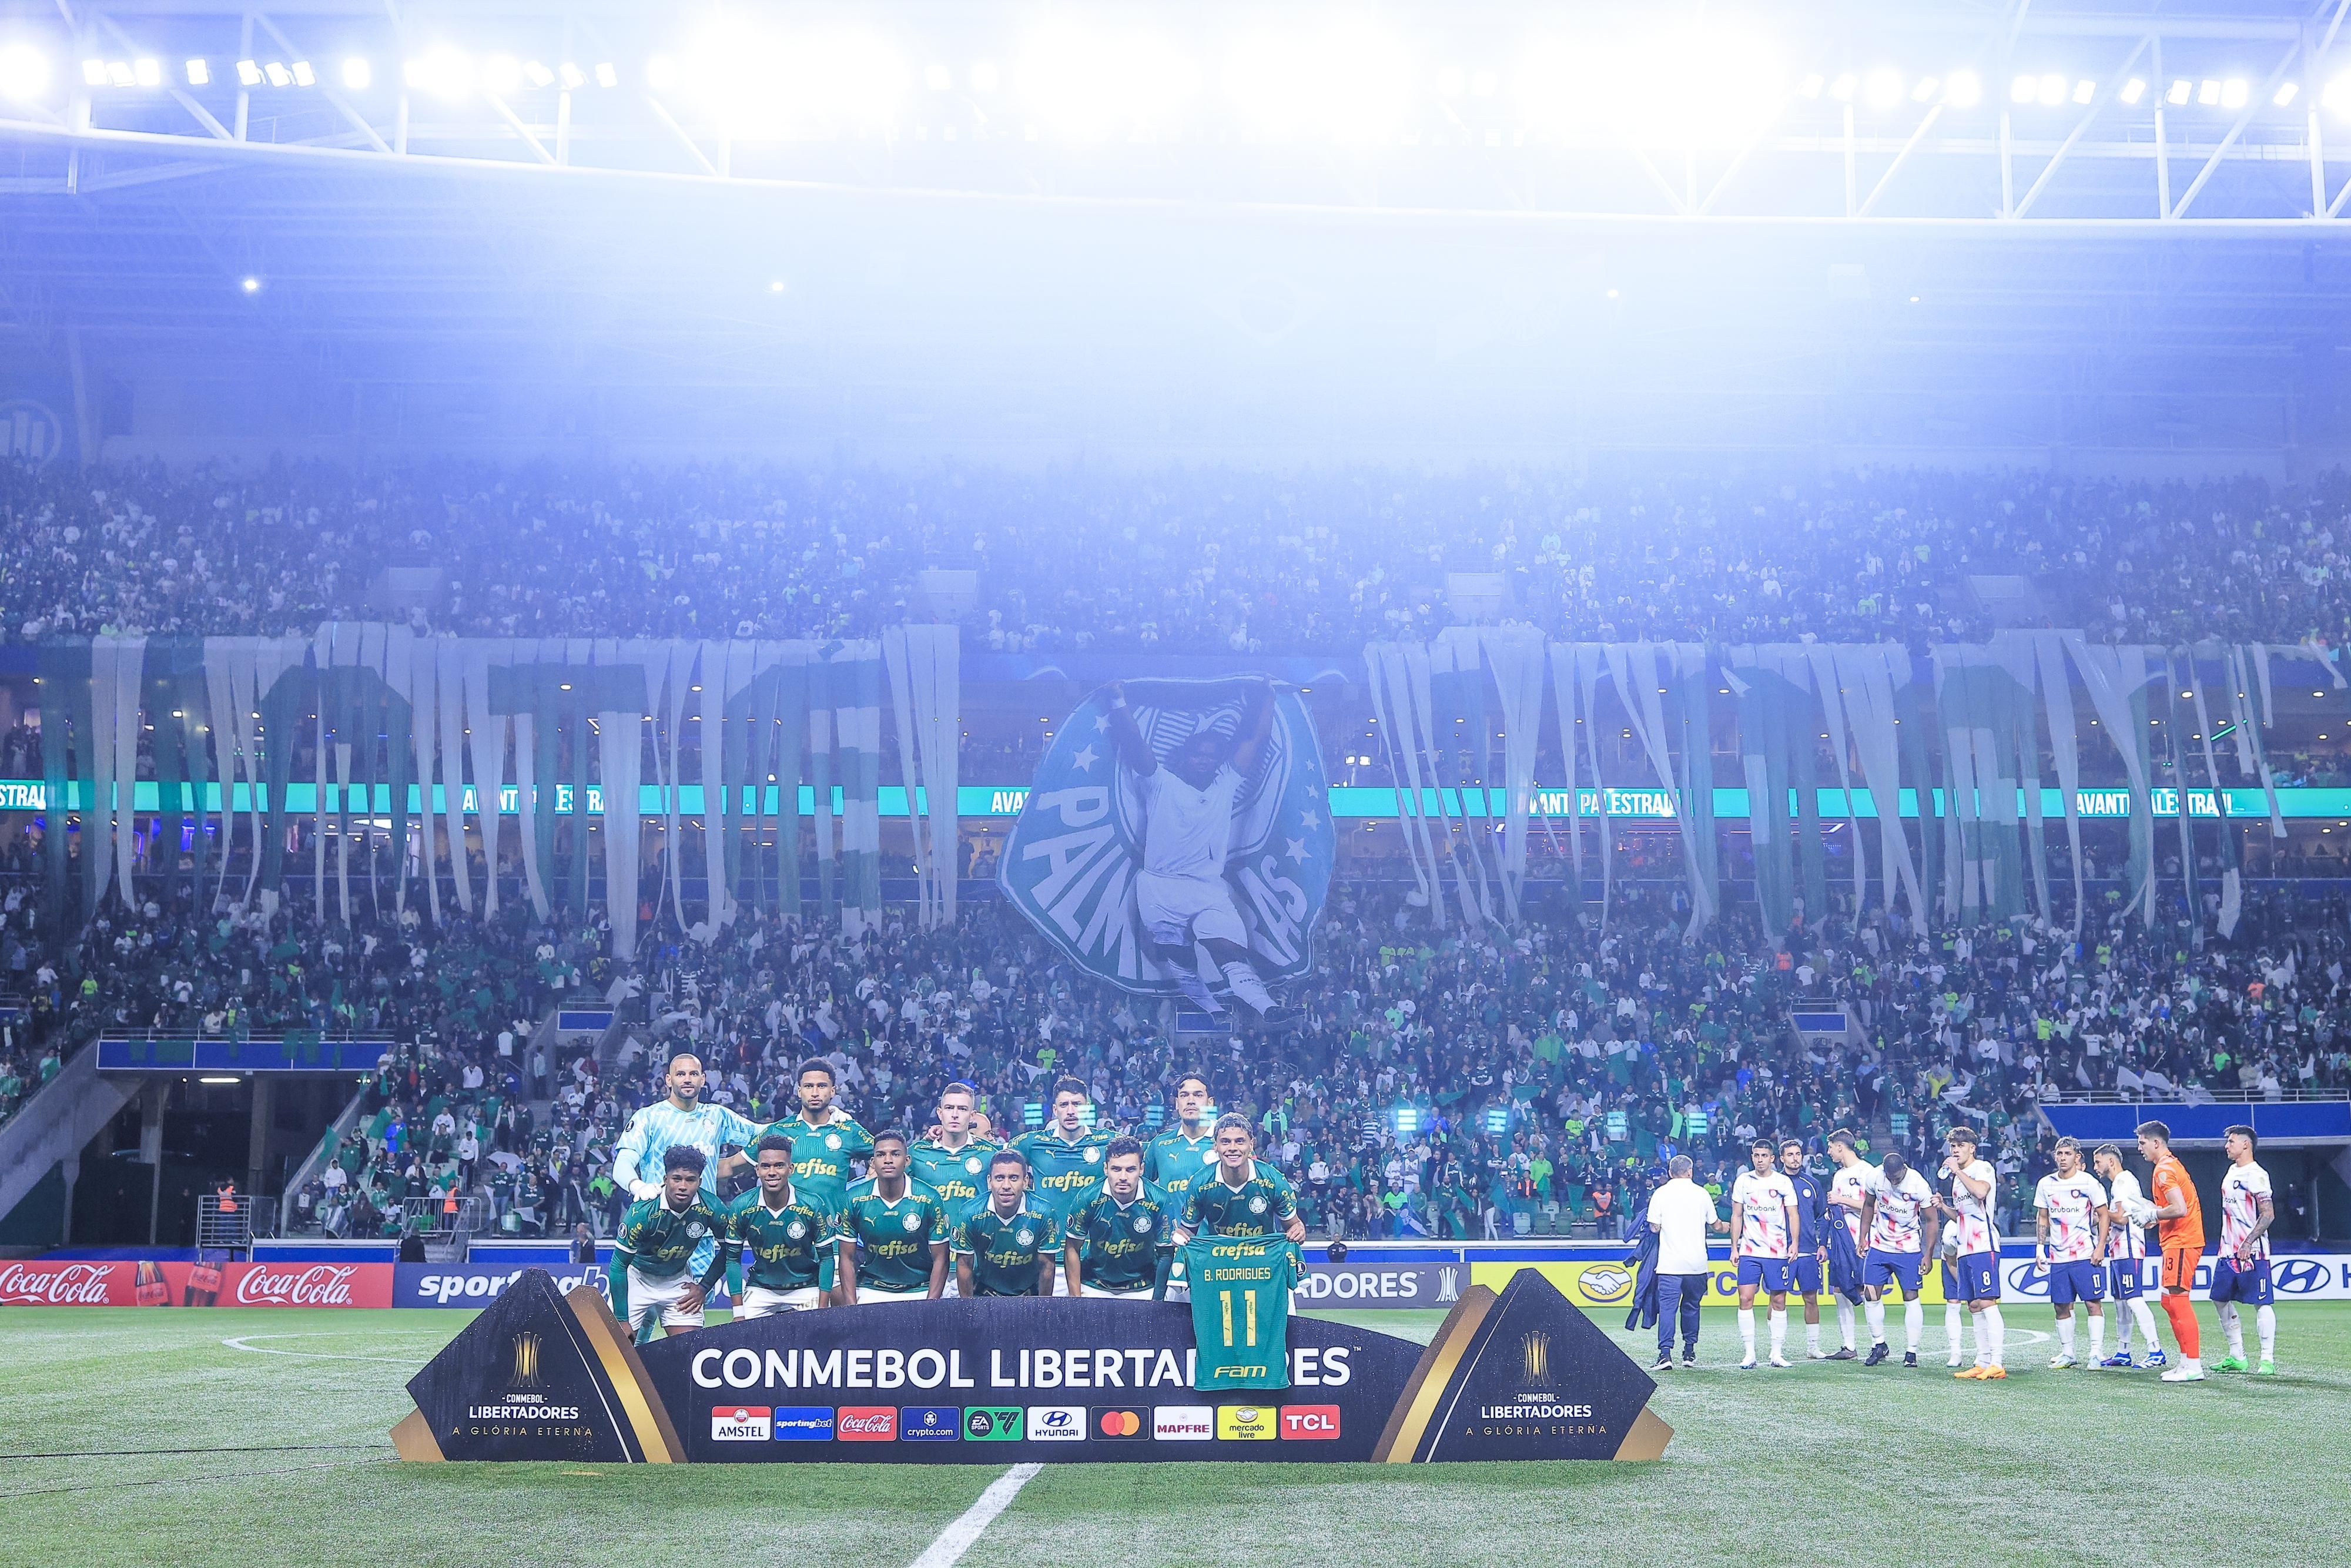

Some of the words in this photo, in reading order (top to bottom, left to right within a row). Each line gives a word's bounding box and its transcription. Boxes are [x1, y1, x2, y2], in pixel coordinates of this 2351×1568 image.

[793, 1158, 837, 1179] refisa
[1041, 1170, 1095, 1192] crefisa
[1747, 1204, 1777, 1213] brubank
[1879, 1201, 1908, 1215] brubank
[1211, 1242, 1265, 1261] crefisa
[1204, 1269, 1214, 1282] B.
[1215, 1267, 1271, 1281] RODRIGUES
[1981, 1271, 1991, 1286] 8
[2122, 1274, 2134, 1288] 41
[0, 1263, 116, 1304] Coca-Cola
[237, 1265, 358, 1305] Coca-Cola
[2259, 1278, 2266, 1293] 11
[1220, 1289, 1256, 1347] 11
[691, 1348, 975, 1389] CONMEBOL
[990, 1348, 1351, 1388] LIBERTAES
[468, 1405, 579, 1420] LIBERTADORES
[1481, 1405, 1592, 1419] LIBERTADORES
[776, 1419, 832, 1429] sportingbet
[839, 1415, 894, 1433] Coca-Cola
[971, 1416, 990, 1425] EA
[1285, 1414, 1335, 1431] TCL
[451, 1427, 461, 1436] A
[470, 1425, 528, 1436] GLÓRIA
[538, 1427, 593, 1437] ETERNA
[718, 1426, 763, 1437] AMSTEL
[907, 1428, 953, 1438] crypto.com
[1157, 1424, 1210, 1433] MAPFRE
[1465, 1427, 1474, 1436] A
[1483, 1424, 1542, 1436] GLÓRIA
[1551, 1425, 1607, 1435] ETERNA
